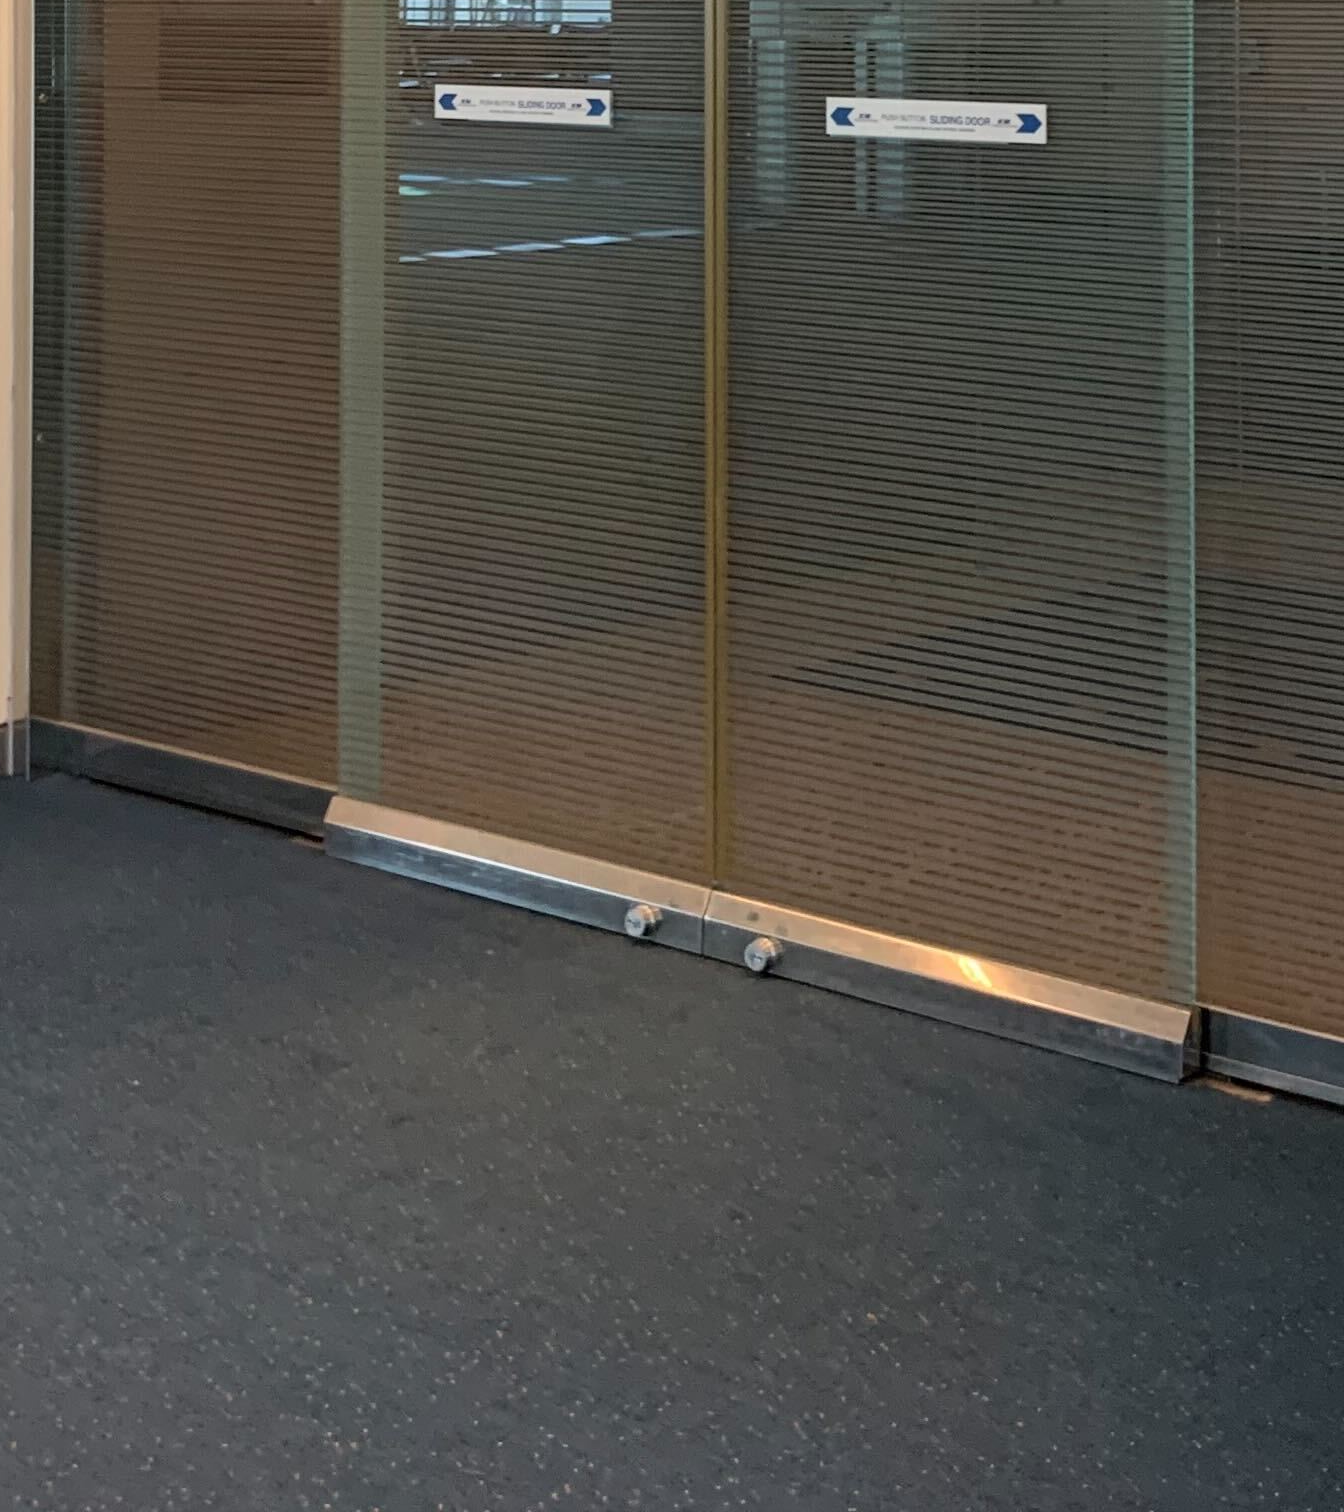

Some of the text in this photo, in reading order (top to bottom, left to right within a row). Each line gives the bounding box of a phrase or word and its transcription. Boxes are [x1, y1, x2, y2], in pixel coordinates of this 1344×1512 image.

[517, 100, 544, 109] SLIDING
[546, 101, 566, 110] DOOR
[929, 114, 963, 125] SLIDING
[965, 116, 991, 126] DOOR
